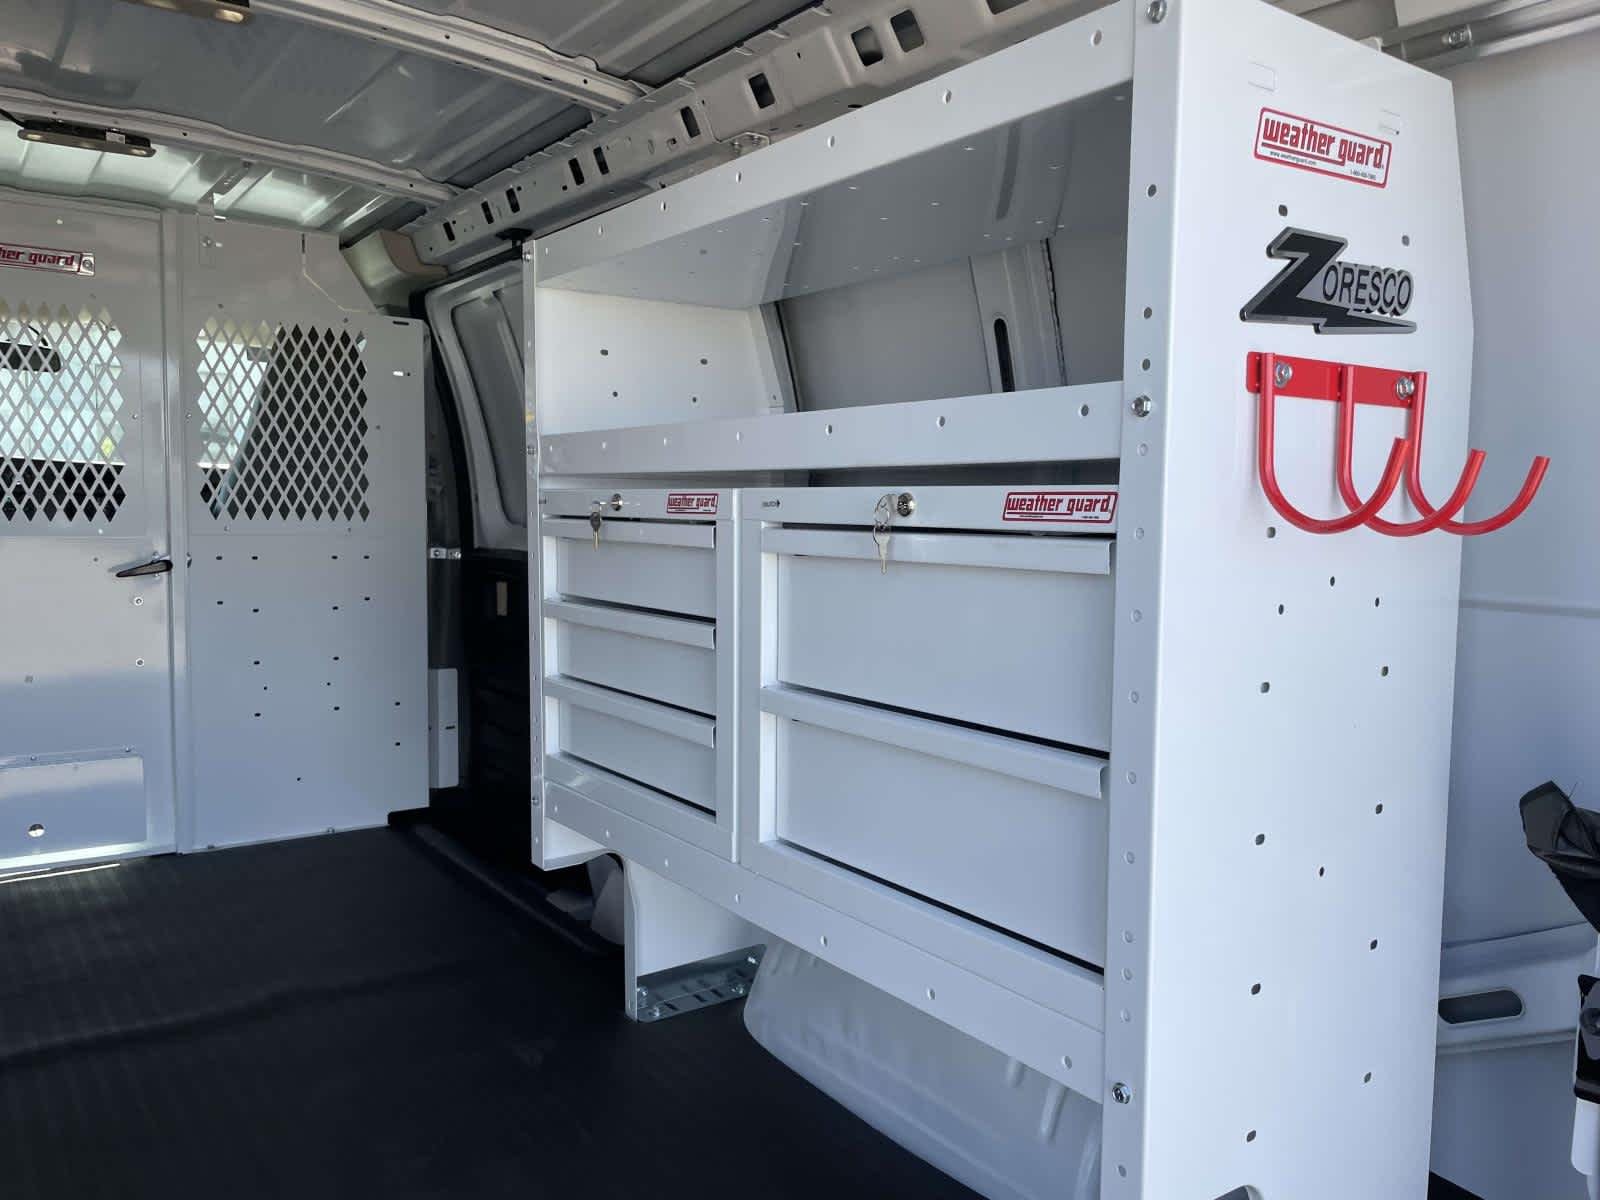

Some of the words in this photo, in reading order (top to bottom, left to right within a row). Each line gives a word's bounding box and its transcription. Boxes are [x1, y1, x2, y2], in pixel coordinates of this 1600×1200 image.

[1262, 117, 1336, 156] weather
[28, 252, 75, 266] guard
[1240, 226, 1417, 335] ZORESCO
[668, 496, 695, 507] weather
[1006, 495, 1063, 512] weather
[1066, 495, 1110, 513] guard
